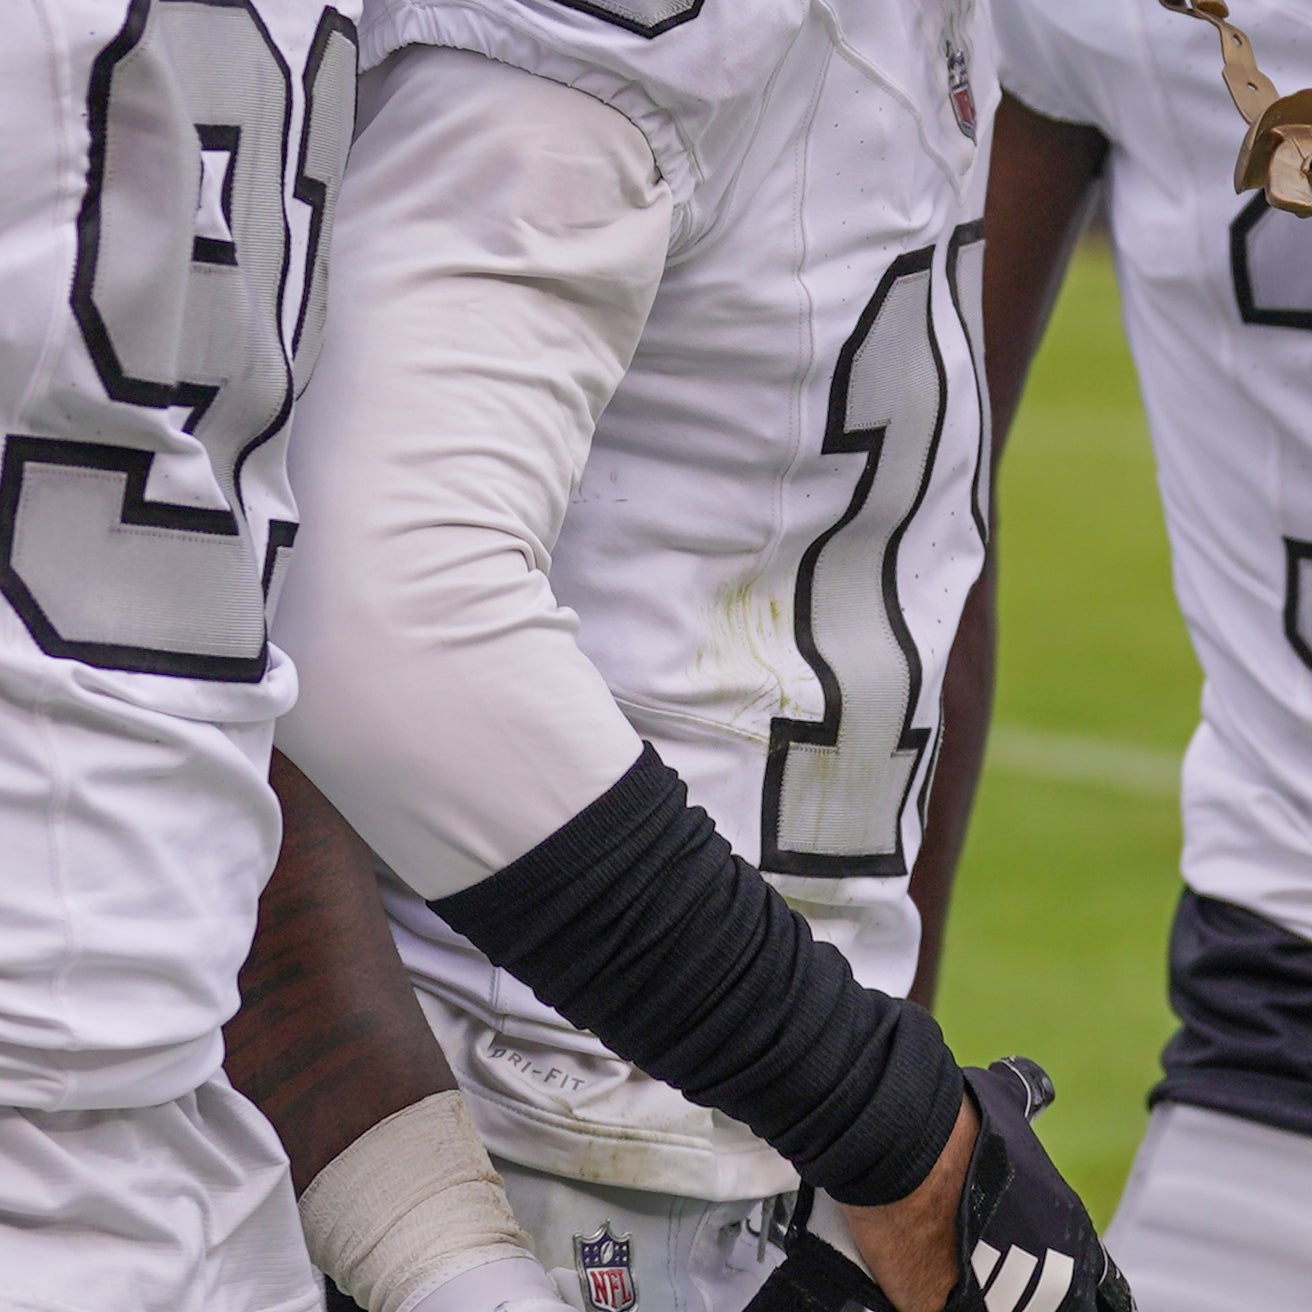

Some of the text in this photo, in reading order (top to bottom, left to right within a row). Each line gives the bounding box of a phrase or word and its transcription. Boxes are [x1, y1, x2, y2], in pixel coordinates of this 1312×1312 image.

[760, 219, 990, 877] 1
[490, 1048, 587, 1092] DRI-FIT
[590, 1269, 633, 1310] NFL
